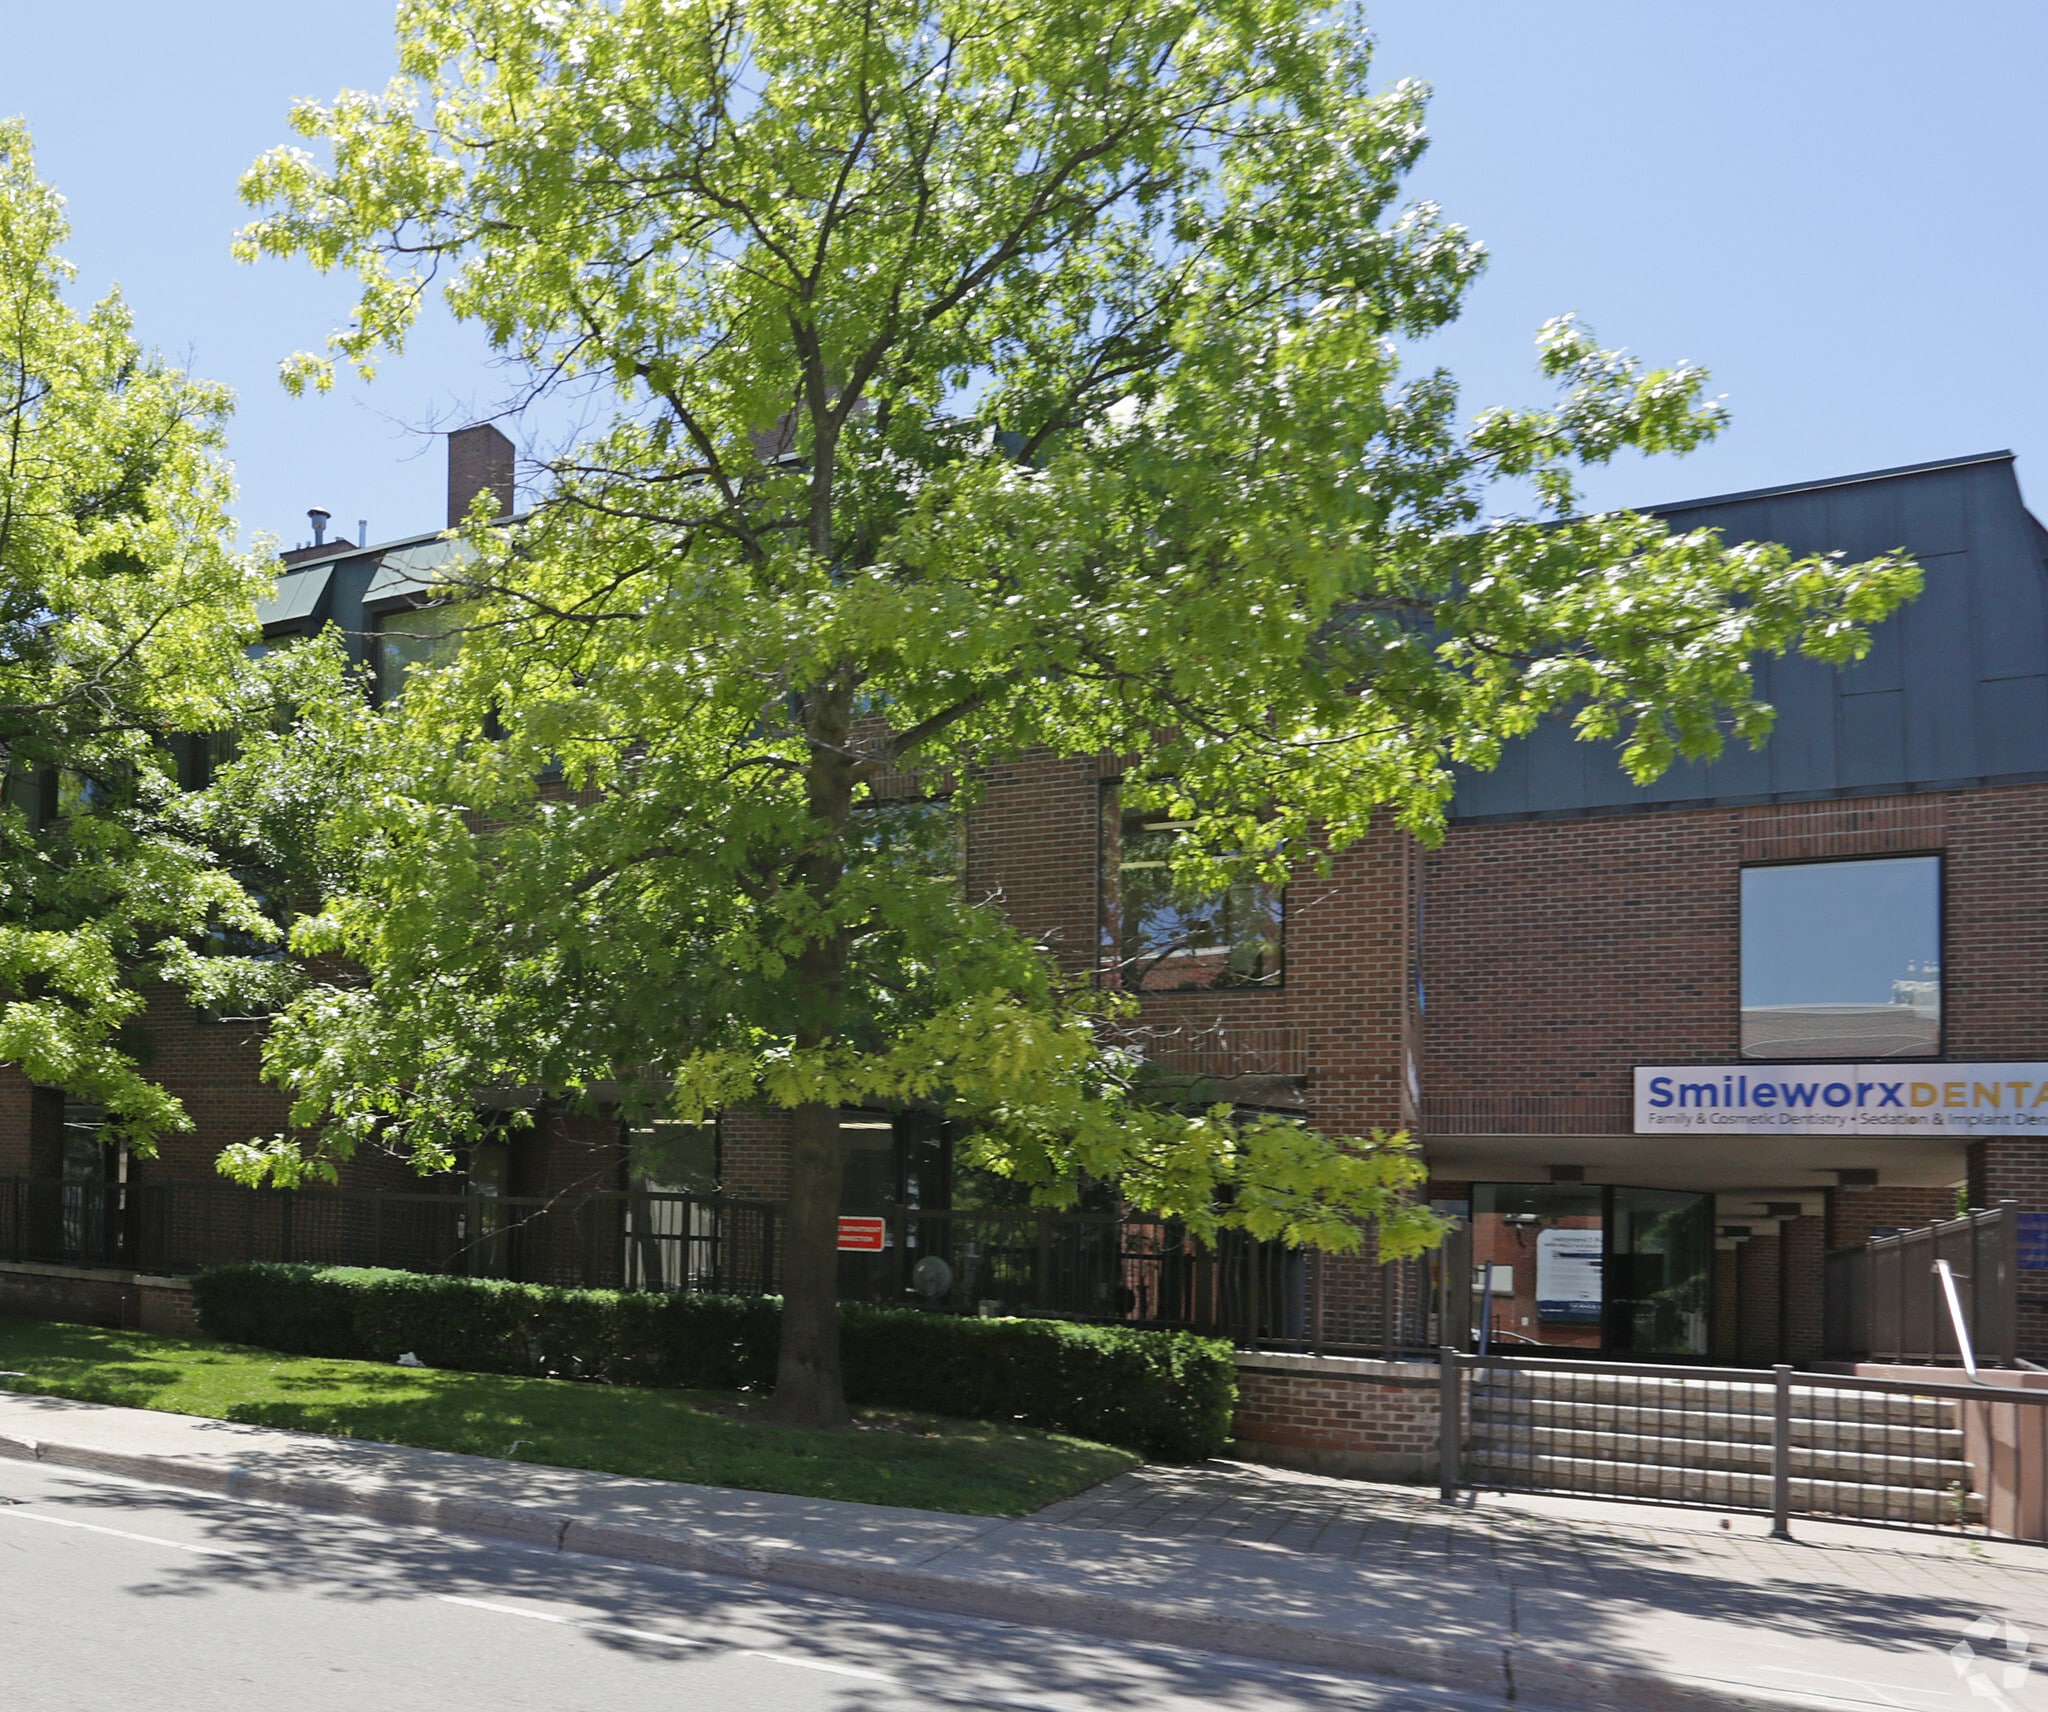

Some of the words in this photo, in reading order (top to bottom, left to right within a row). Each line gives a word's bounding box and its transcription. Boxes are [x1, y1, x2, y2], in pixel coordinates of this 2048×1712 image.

[1649, 1112, 1693, 1127] Family
[1696, 1113, 1707, 1124] &
[1709, 1112, 1776, 1125] Cosmetic
[1779, 1112, 1847, 1127] Dentistry
[1860, 1112, 1929, 1126] Sedation
[1932, 1113, 1944, 1126] &
[1948, 1112, 2011, 1127] Implant
